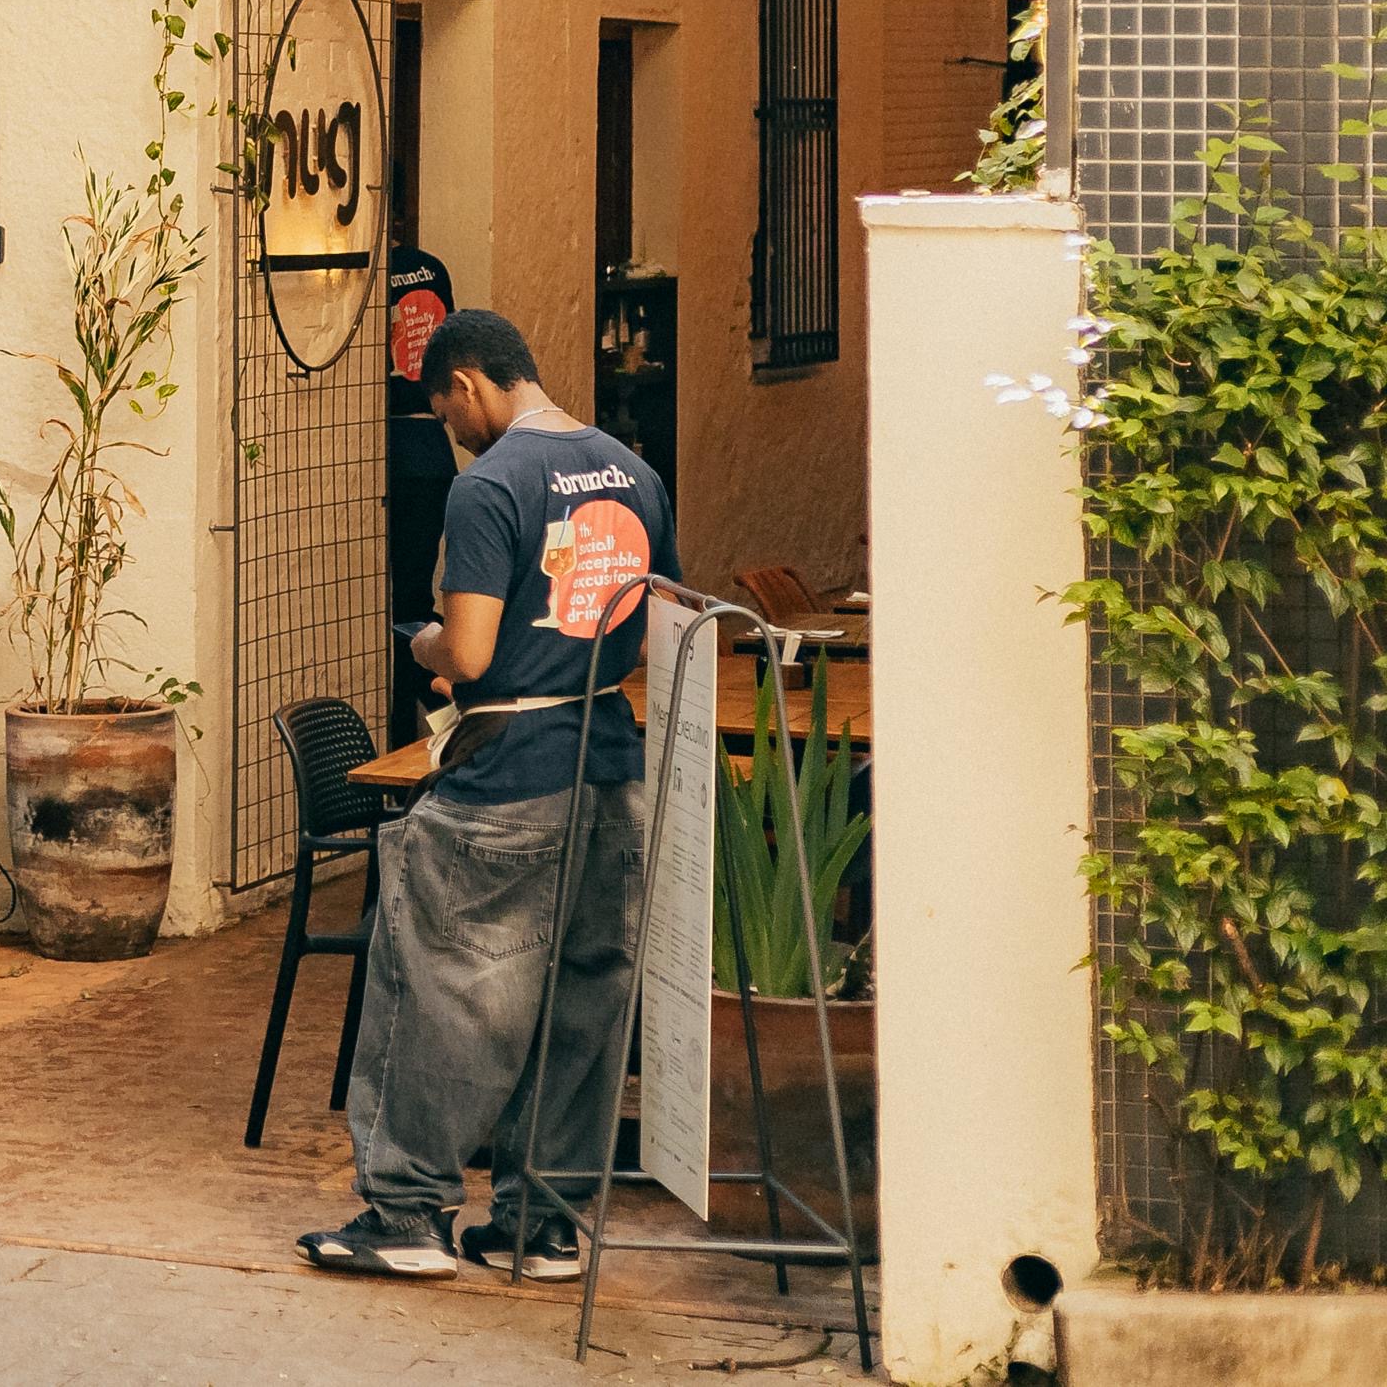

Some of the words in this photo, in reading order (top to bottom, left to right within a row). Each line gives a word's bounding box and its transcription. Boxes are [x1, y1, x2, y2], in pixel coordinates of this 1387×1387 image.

[577, 551, 642, 573] accepable
[572, 573, 612, 589] excus
[673, 621, 695, 662] mg
